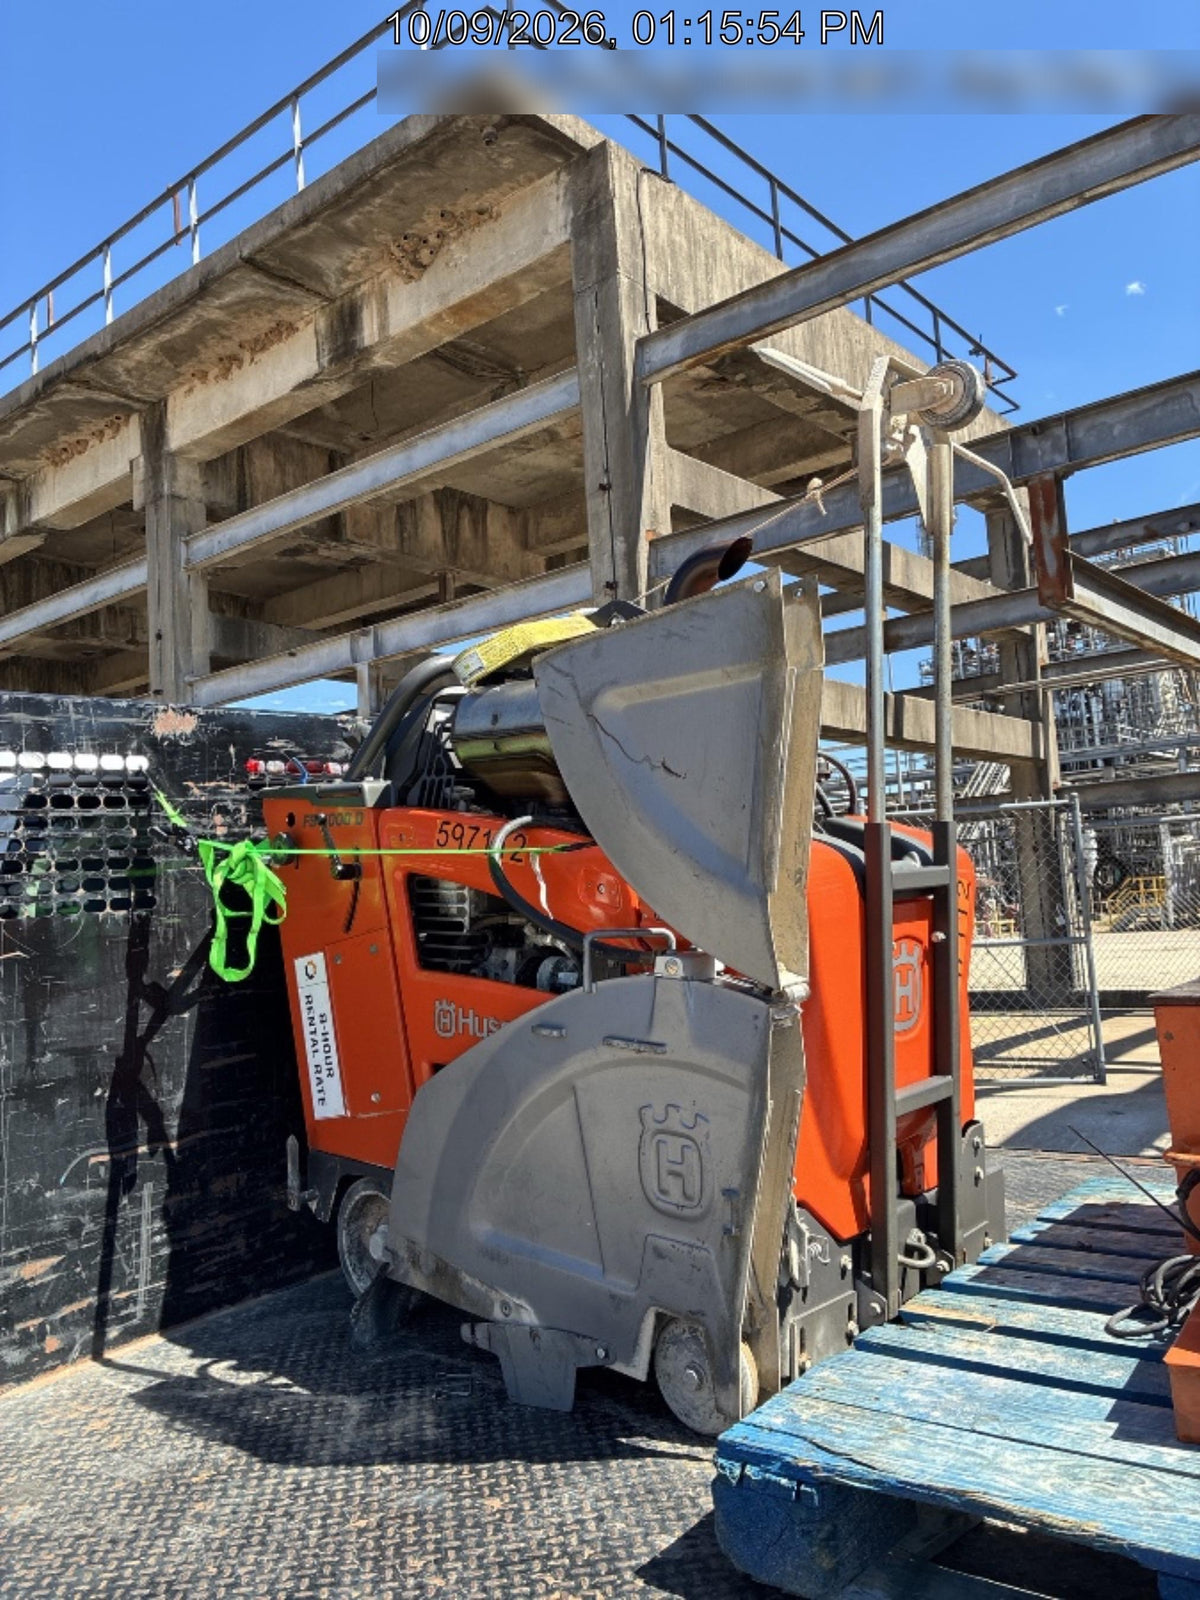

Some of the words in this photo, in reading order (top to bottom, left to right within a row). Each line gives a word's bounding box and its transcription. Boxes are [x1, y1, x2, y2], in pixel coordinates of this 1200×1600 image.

[437, 821, 527, 862] 59712
[304, 994, 320, 1058] RENTAL
[314, 1064, 327, 1106] RATE
[319, 1012, 334, 1078] 8-HOUR
